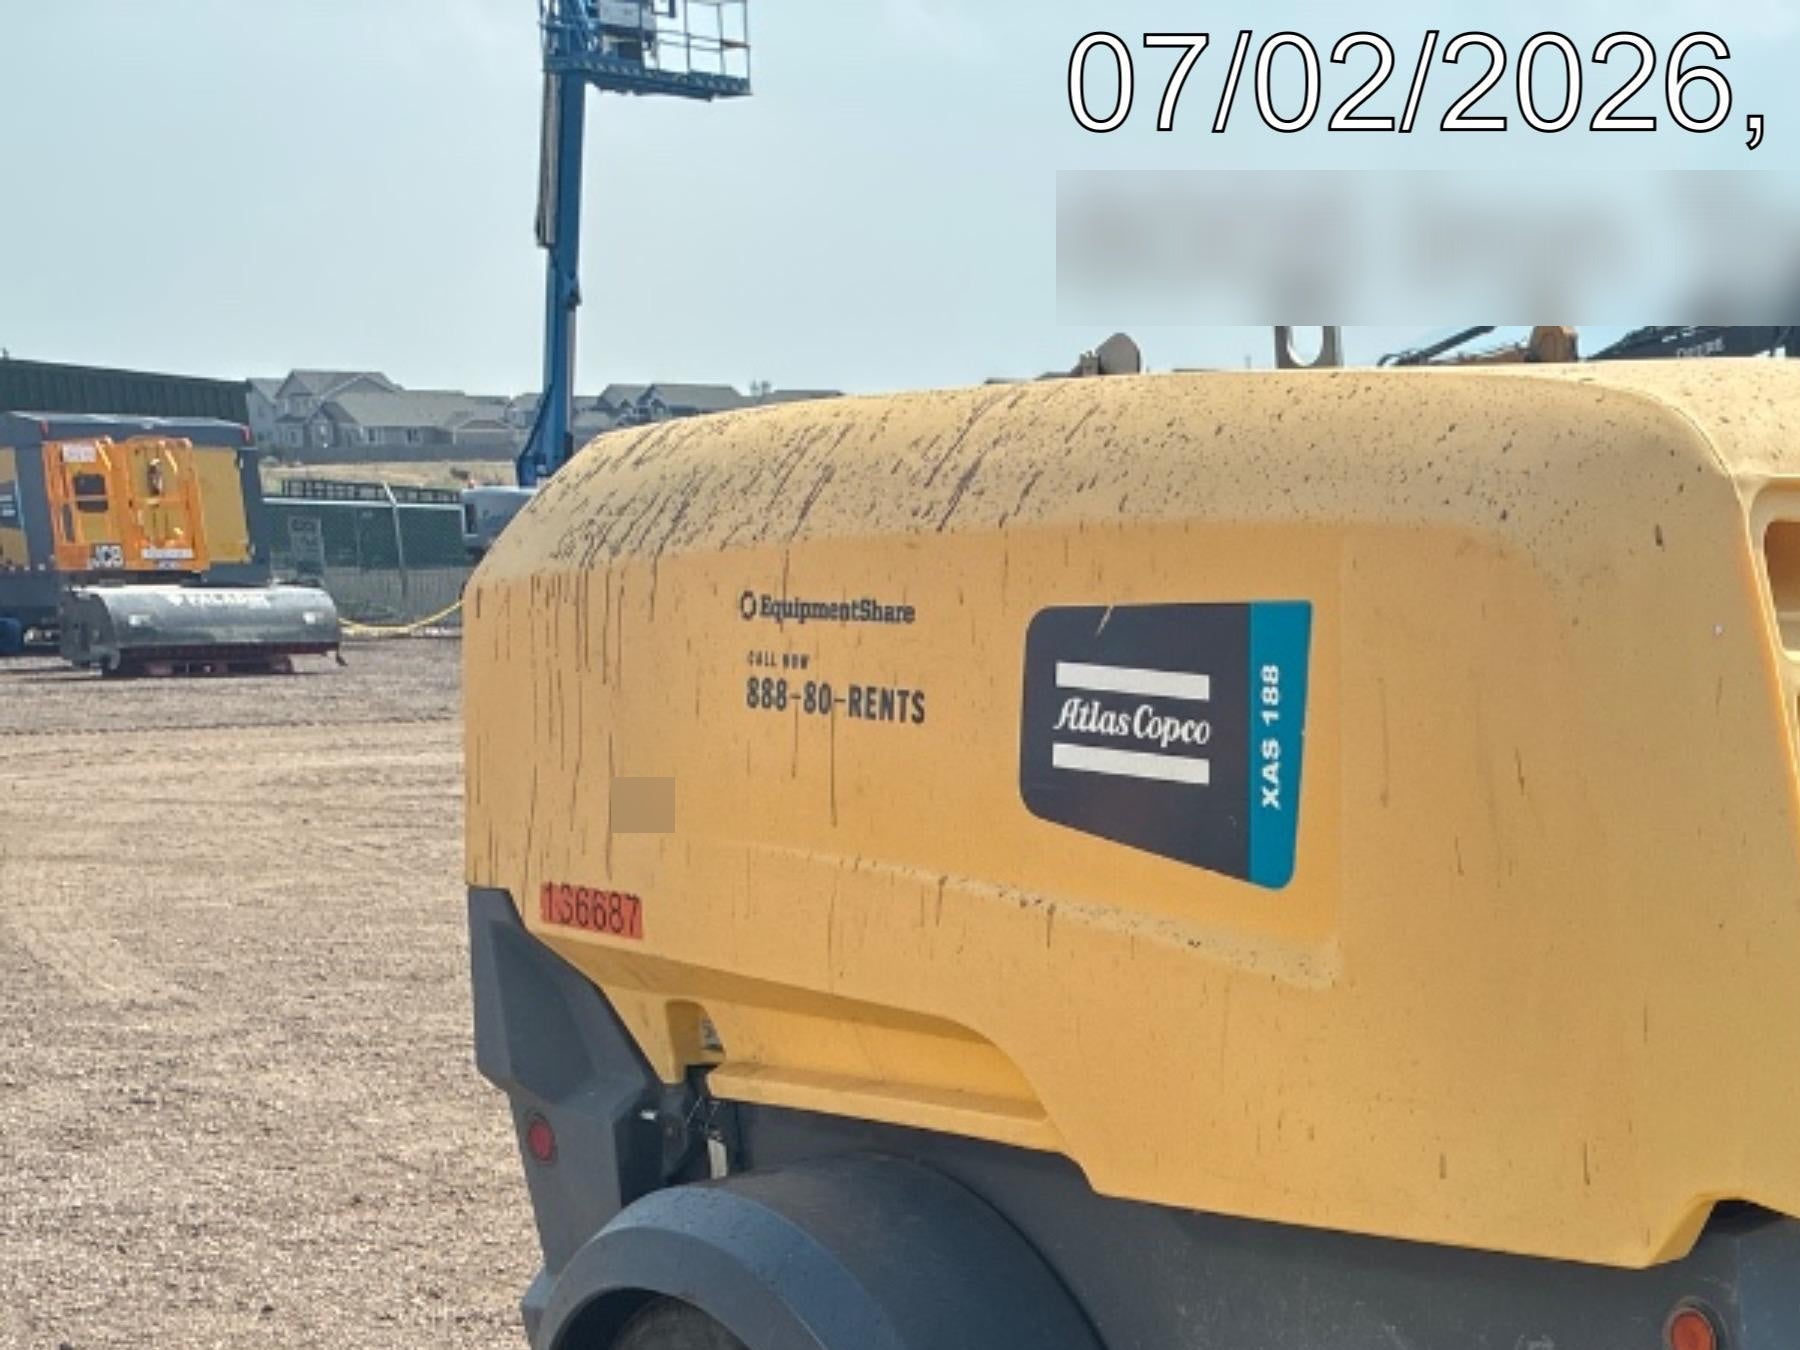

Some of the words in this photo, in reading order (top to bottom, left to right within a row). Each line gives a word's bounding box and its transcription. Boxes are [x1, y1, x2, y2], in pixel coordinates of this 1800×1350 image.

[760, 594, 915, 623] EquipmentShare
[747, 651, 777, 667] CALL
[747, 677, 925, 724] 888-80-RENTS
[1261, 664, 1280, 725] 188
[1053, 697, 1131, 736] Atlas
[1132, 704, 1211, 748] Copco
[1261, 738, 1281, 809] XAS
[545, 880, 641, 937] 136687
